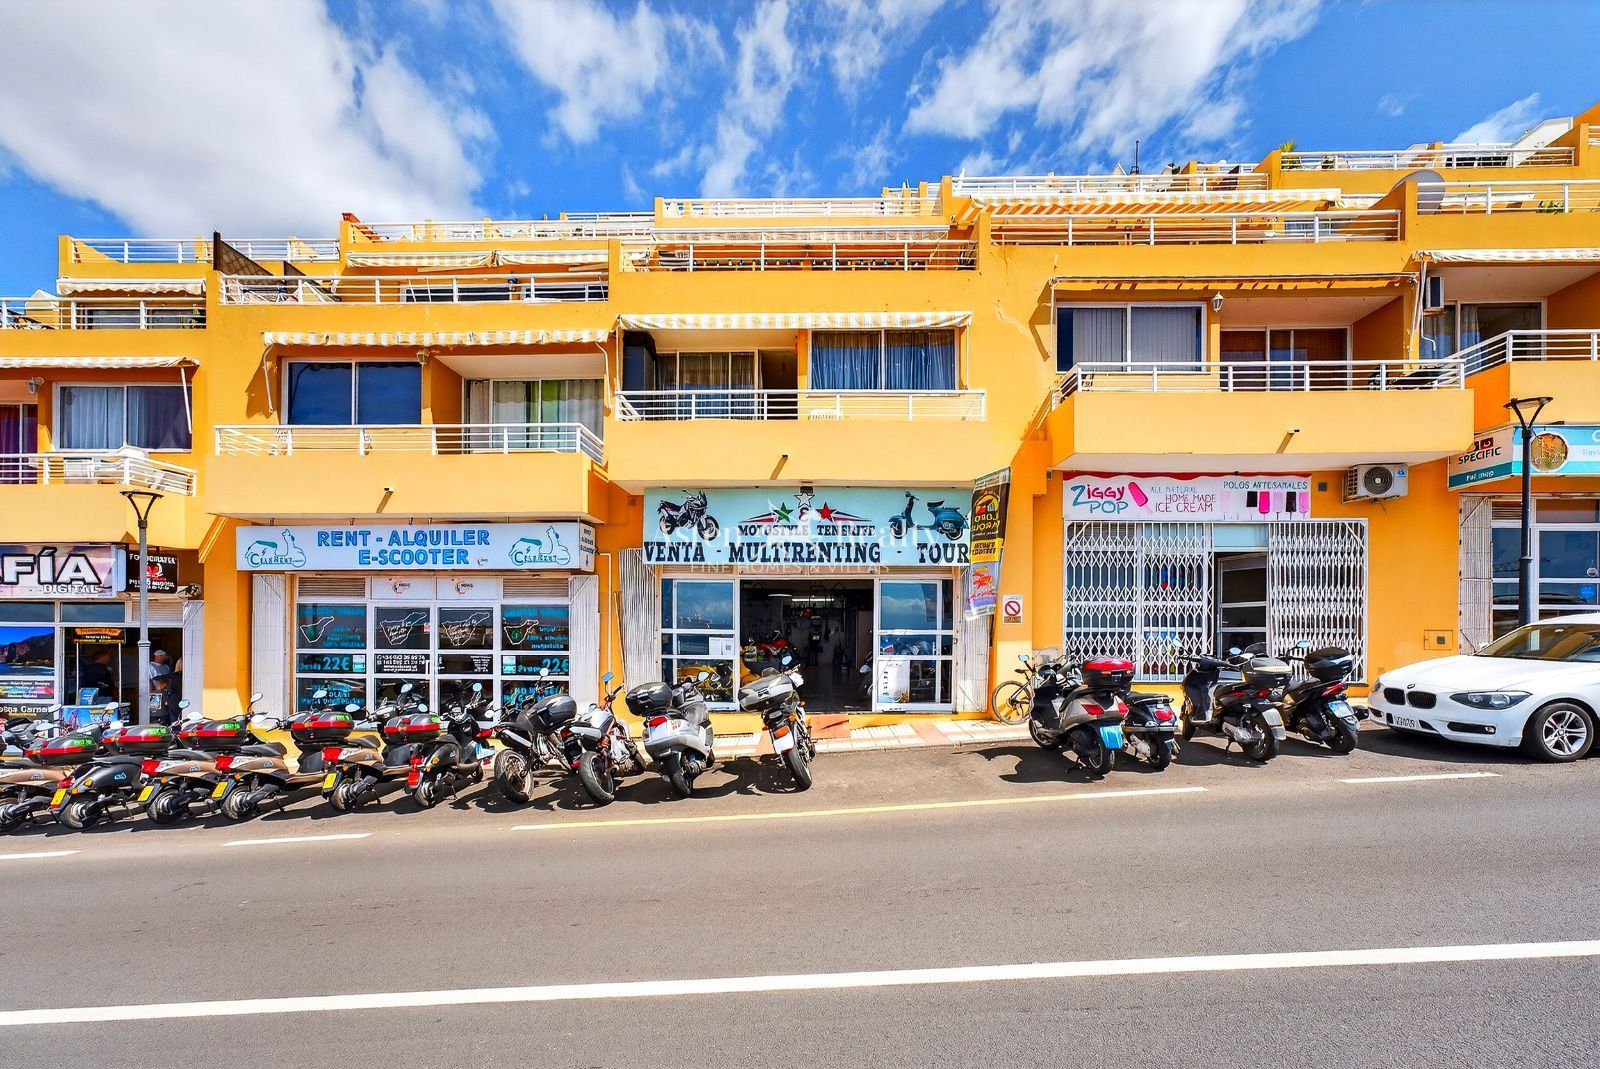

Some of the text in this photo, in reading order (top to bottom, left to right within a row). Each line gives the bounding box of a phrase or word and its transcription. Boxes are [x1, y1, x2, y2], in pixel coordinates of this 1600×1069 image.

[1458, 446, 1502, 465] SPECIFIC
[1223, 481, 1249, 490] POLOS
[1165, 494, 1217, 504] HOME MADE
[1090, 500, 1129, 514] POP
[1155, 502, 1213, 513] ICE CREAM
[317, 530, 371, 547] RENT
[388, 529, 490, 547] ALQUILER
[738, 525, 808, 537] MOTOSTYLE
[358, 549, 470, 565] E-SCOOTER
[644, 541, 705, 563] VENTA
[728, 541, 881, 564] MULTIRENTING
[917, 543, 970, 564] TOUR
[42, 582, 100, 595] DIGITAL
[322, 656, 350, 671] 22€
